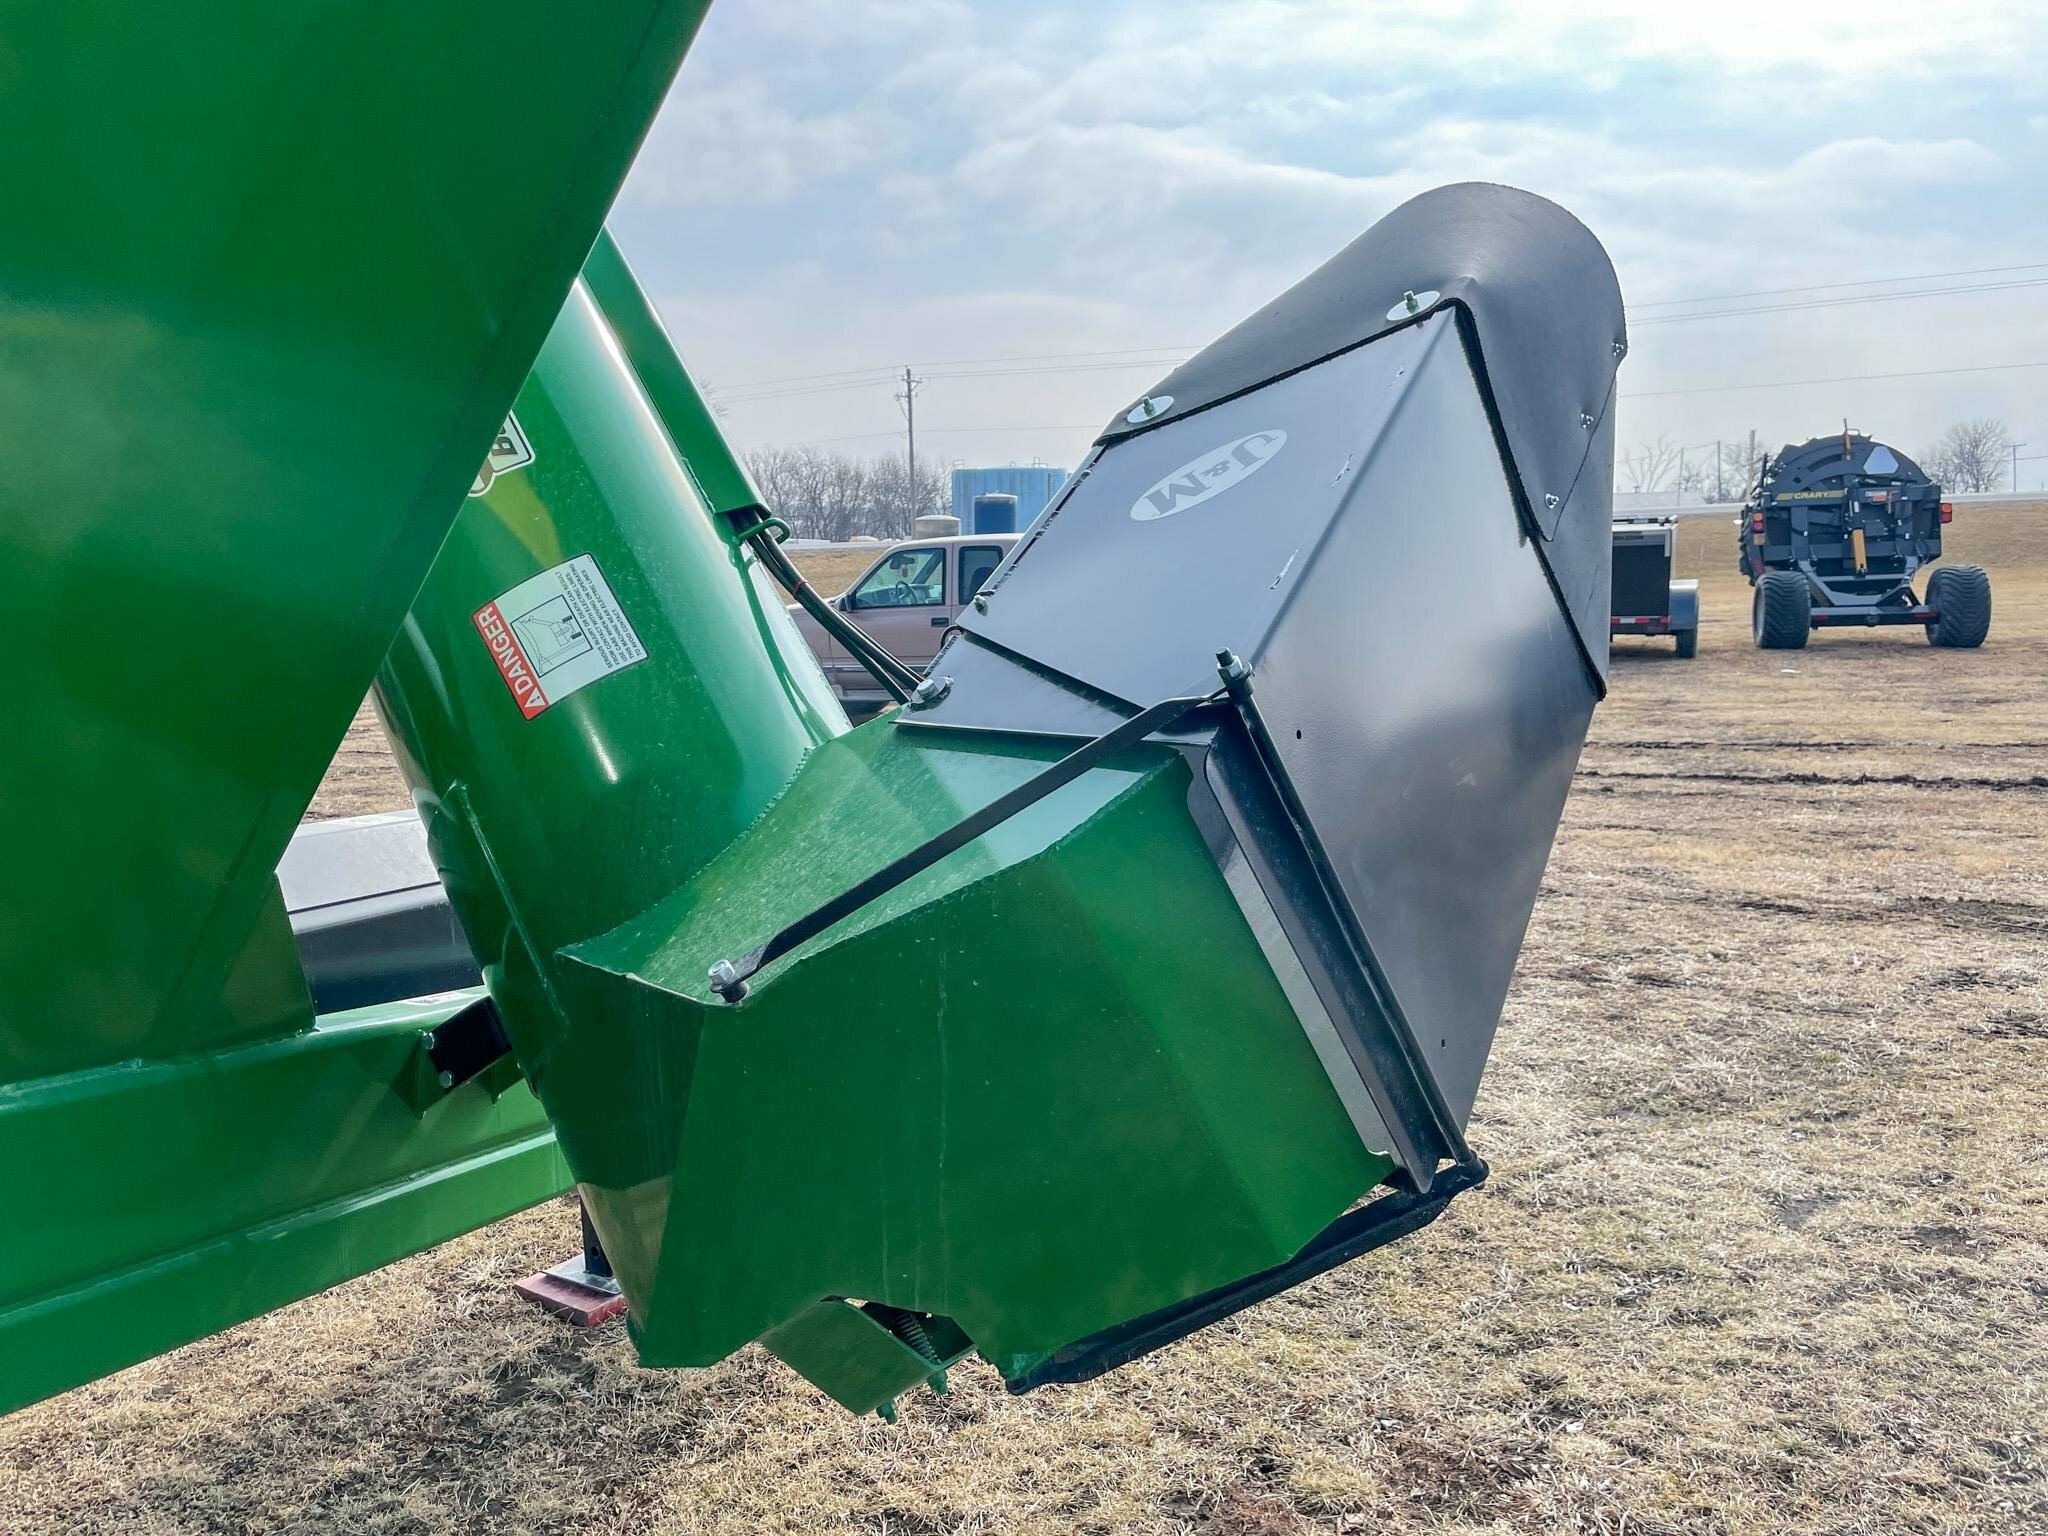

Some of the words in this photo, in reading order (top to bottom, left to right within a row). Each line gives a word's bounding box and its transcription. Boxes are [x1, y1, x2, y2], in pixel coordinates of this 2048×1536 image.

[1144, 433, 1279, 517] J&M
[568, 563, 588, 592] OPERATING
[565, 590, 575, 602] CAN
[573, 587, 590, 612] ELECTRIC
[584, 591, 592, 600] OR
[589, 584, 606, 609] ELECTRIC
[572, 601, 585, 619] DEATH
[589, 599, 604, 620] MOVING
[603, 608, 614, 623] NEAR
[581, 618, 590, 627] OR
[587, 612, 598, 626] WITH
[601, 620, 613, 636] WHEN
[611, 622, 627, 647] MACHINE
[594, 624, 611, 650] CONTACT
[609, 635, 621, 651] CARE
[625, 632, 637, 649] AVOID
[479, 607, 534, 695] DANGER
[608, 649, 620, 665] FROM
[618, 650, 627, 662] USE
[624, 646, 634, 659] THIS
[634, 647, 641, 656] TO
